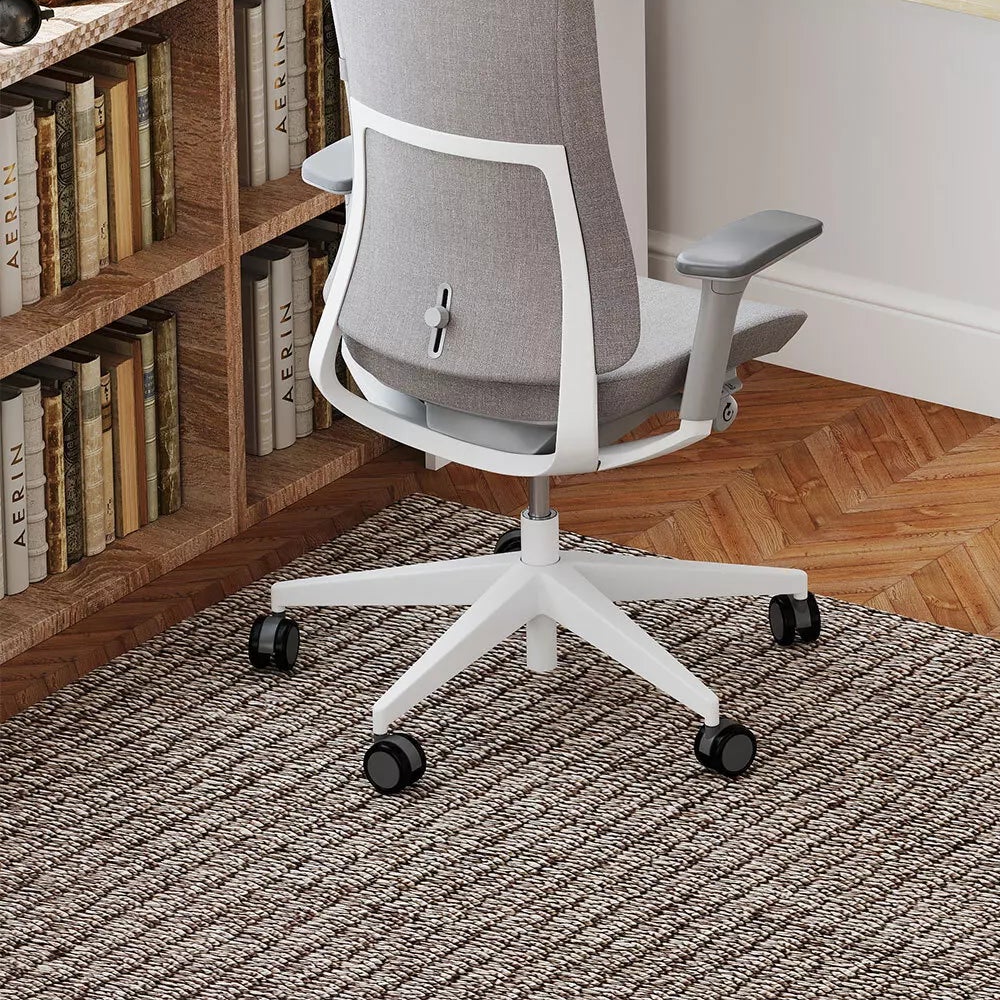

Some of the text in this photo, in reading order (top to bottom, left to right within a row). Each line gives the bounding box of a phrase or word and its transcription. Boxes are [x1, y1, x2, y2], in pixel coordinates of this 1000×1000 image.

[272, 30, 288, 134] AERIN
[3, 162, 20, 269] AERIN
[279, 301, 295, 403] AERIN
[10, 443, 27, 548] AERIN
